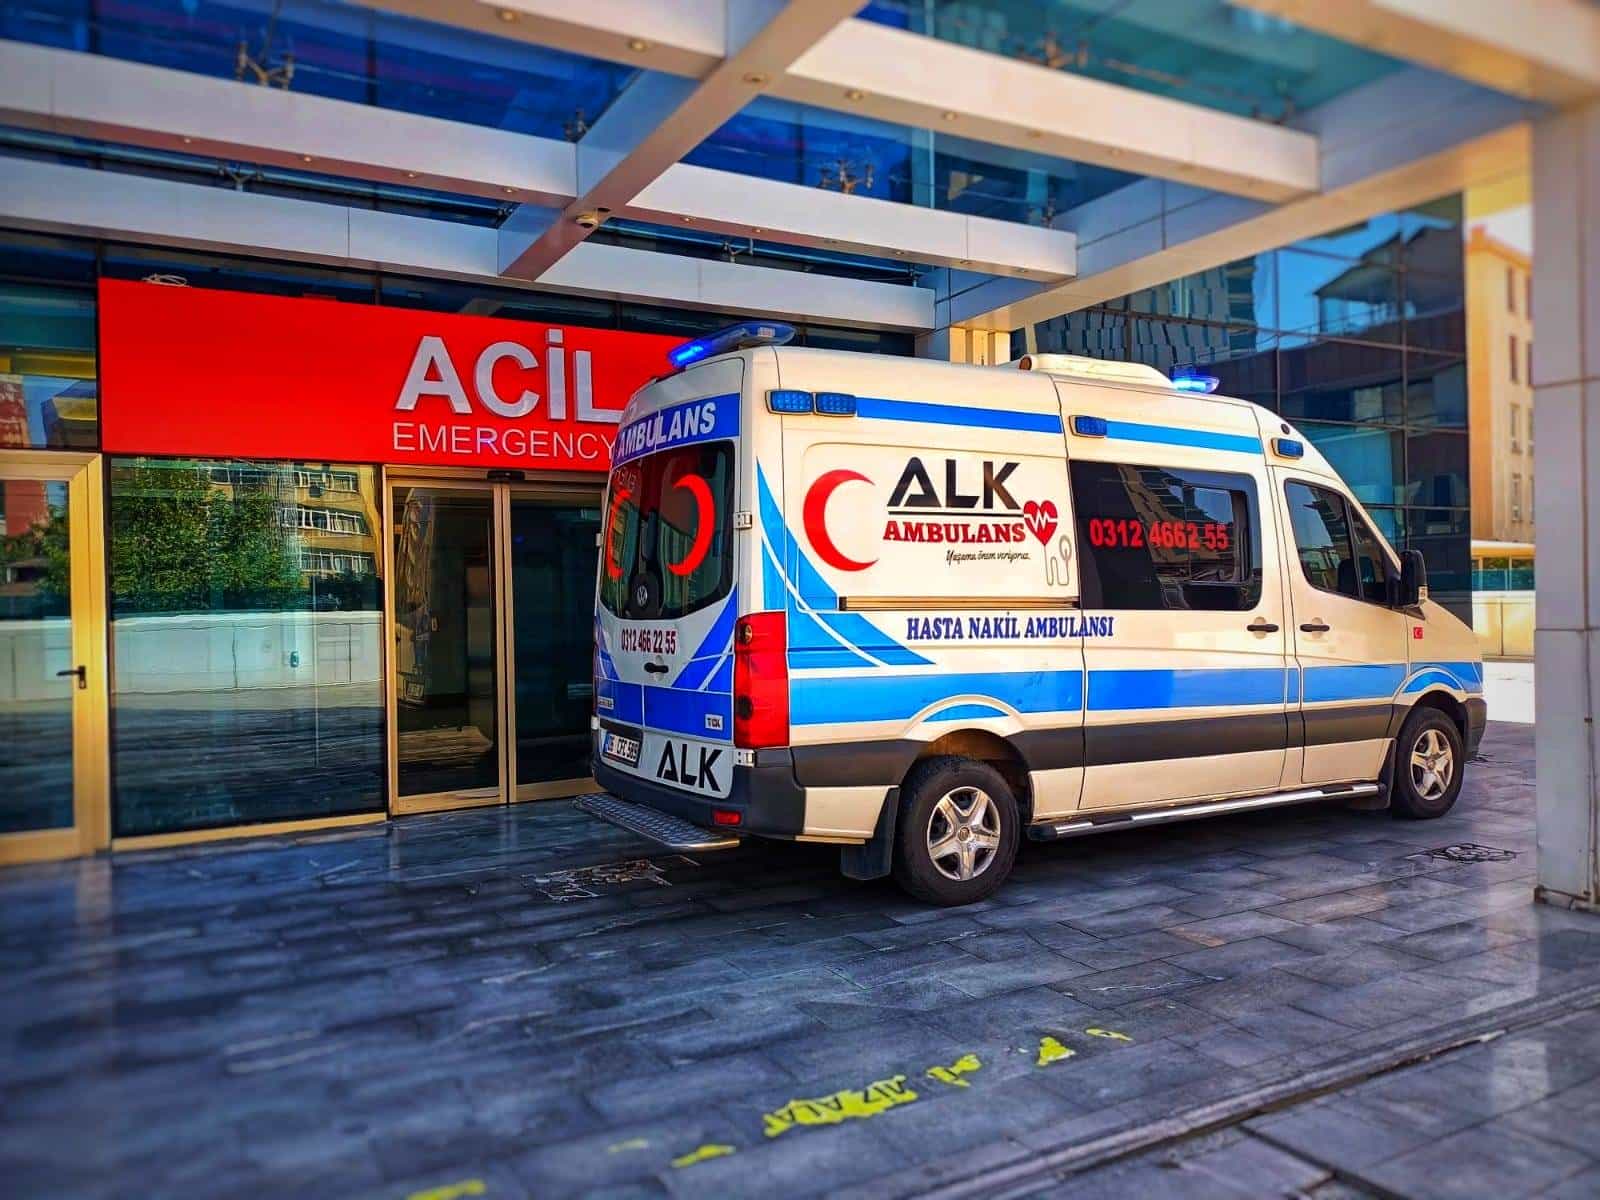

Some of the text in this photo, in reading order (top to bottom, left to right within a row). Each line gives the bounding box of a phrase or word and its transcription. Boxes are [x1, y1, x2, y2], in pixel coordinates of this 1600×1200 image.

[393, 328, 625, 425] ACİL
[392, 421, 616, 460] EMERGENCY
[616, 401, 717, 459] AMBULANS
[886, 456, 1022, 511] ALK
[882, 519, 1028, 544] AMBULANS
[1088, 517, 1144, 550] 0312
[1203, 523, 1230, 550] 55
[621, 628, 677, 655] 0312 466 22 55
[906, 611, 1115, 641] HASTA NAKİL AMBULANSI
[656, 740, 724, 793] ALK
